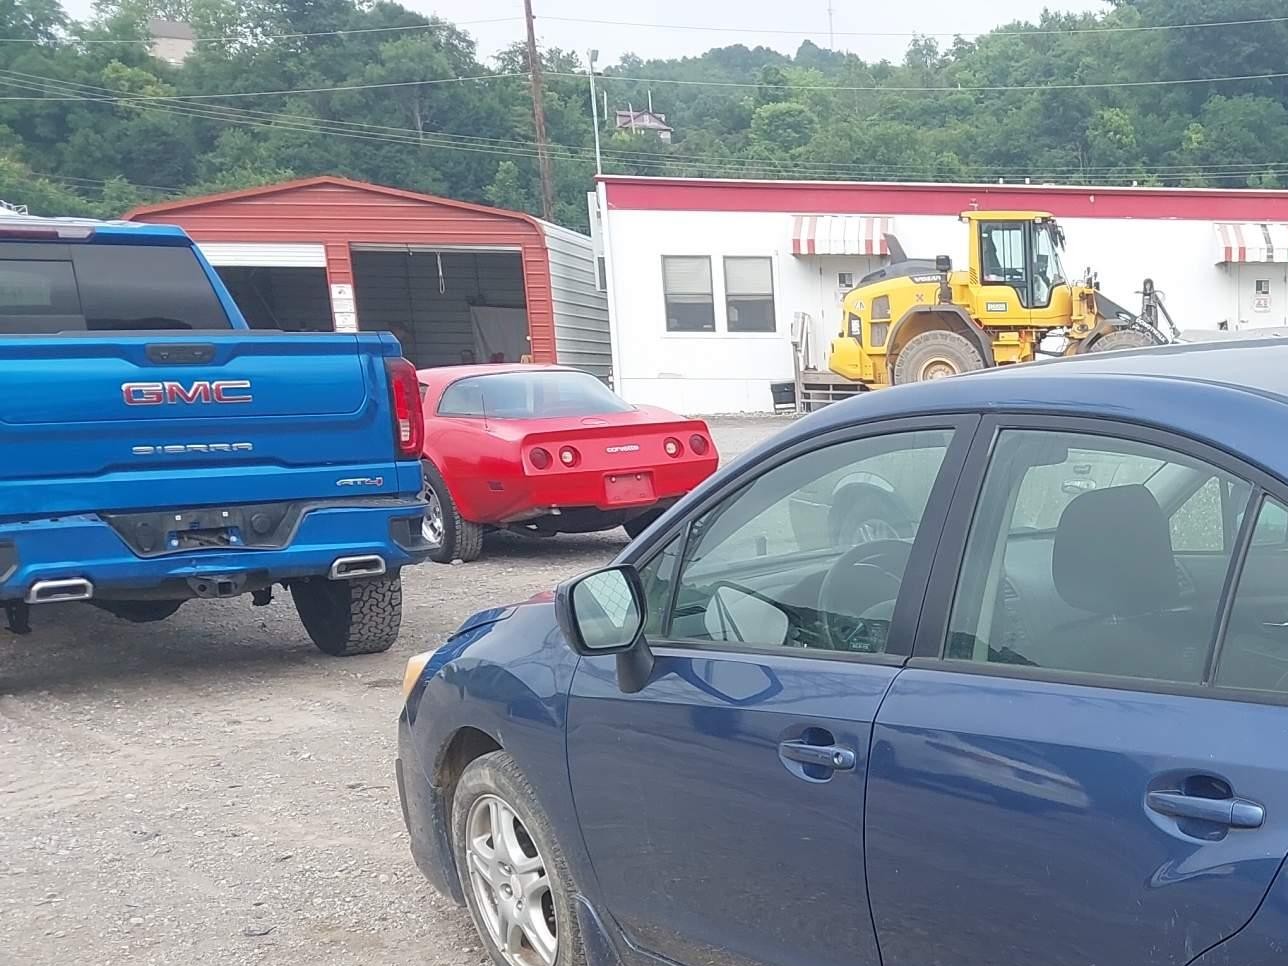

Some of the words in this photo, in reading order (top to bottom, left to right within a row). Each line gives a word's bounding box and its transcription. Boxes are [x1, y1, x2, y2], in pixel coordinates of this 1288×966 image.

[121, 380, 253, 406] GMC
[132, 442, 253, 455] SIERRA
[335, 476, 384, 487] AT4
